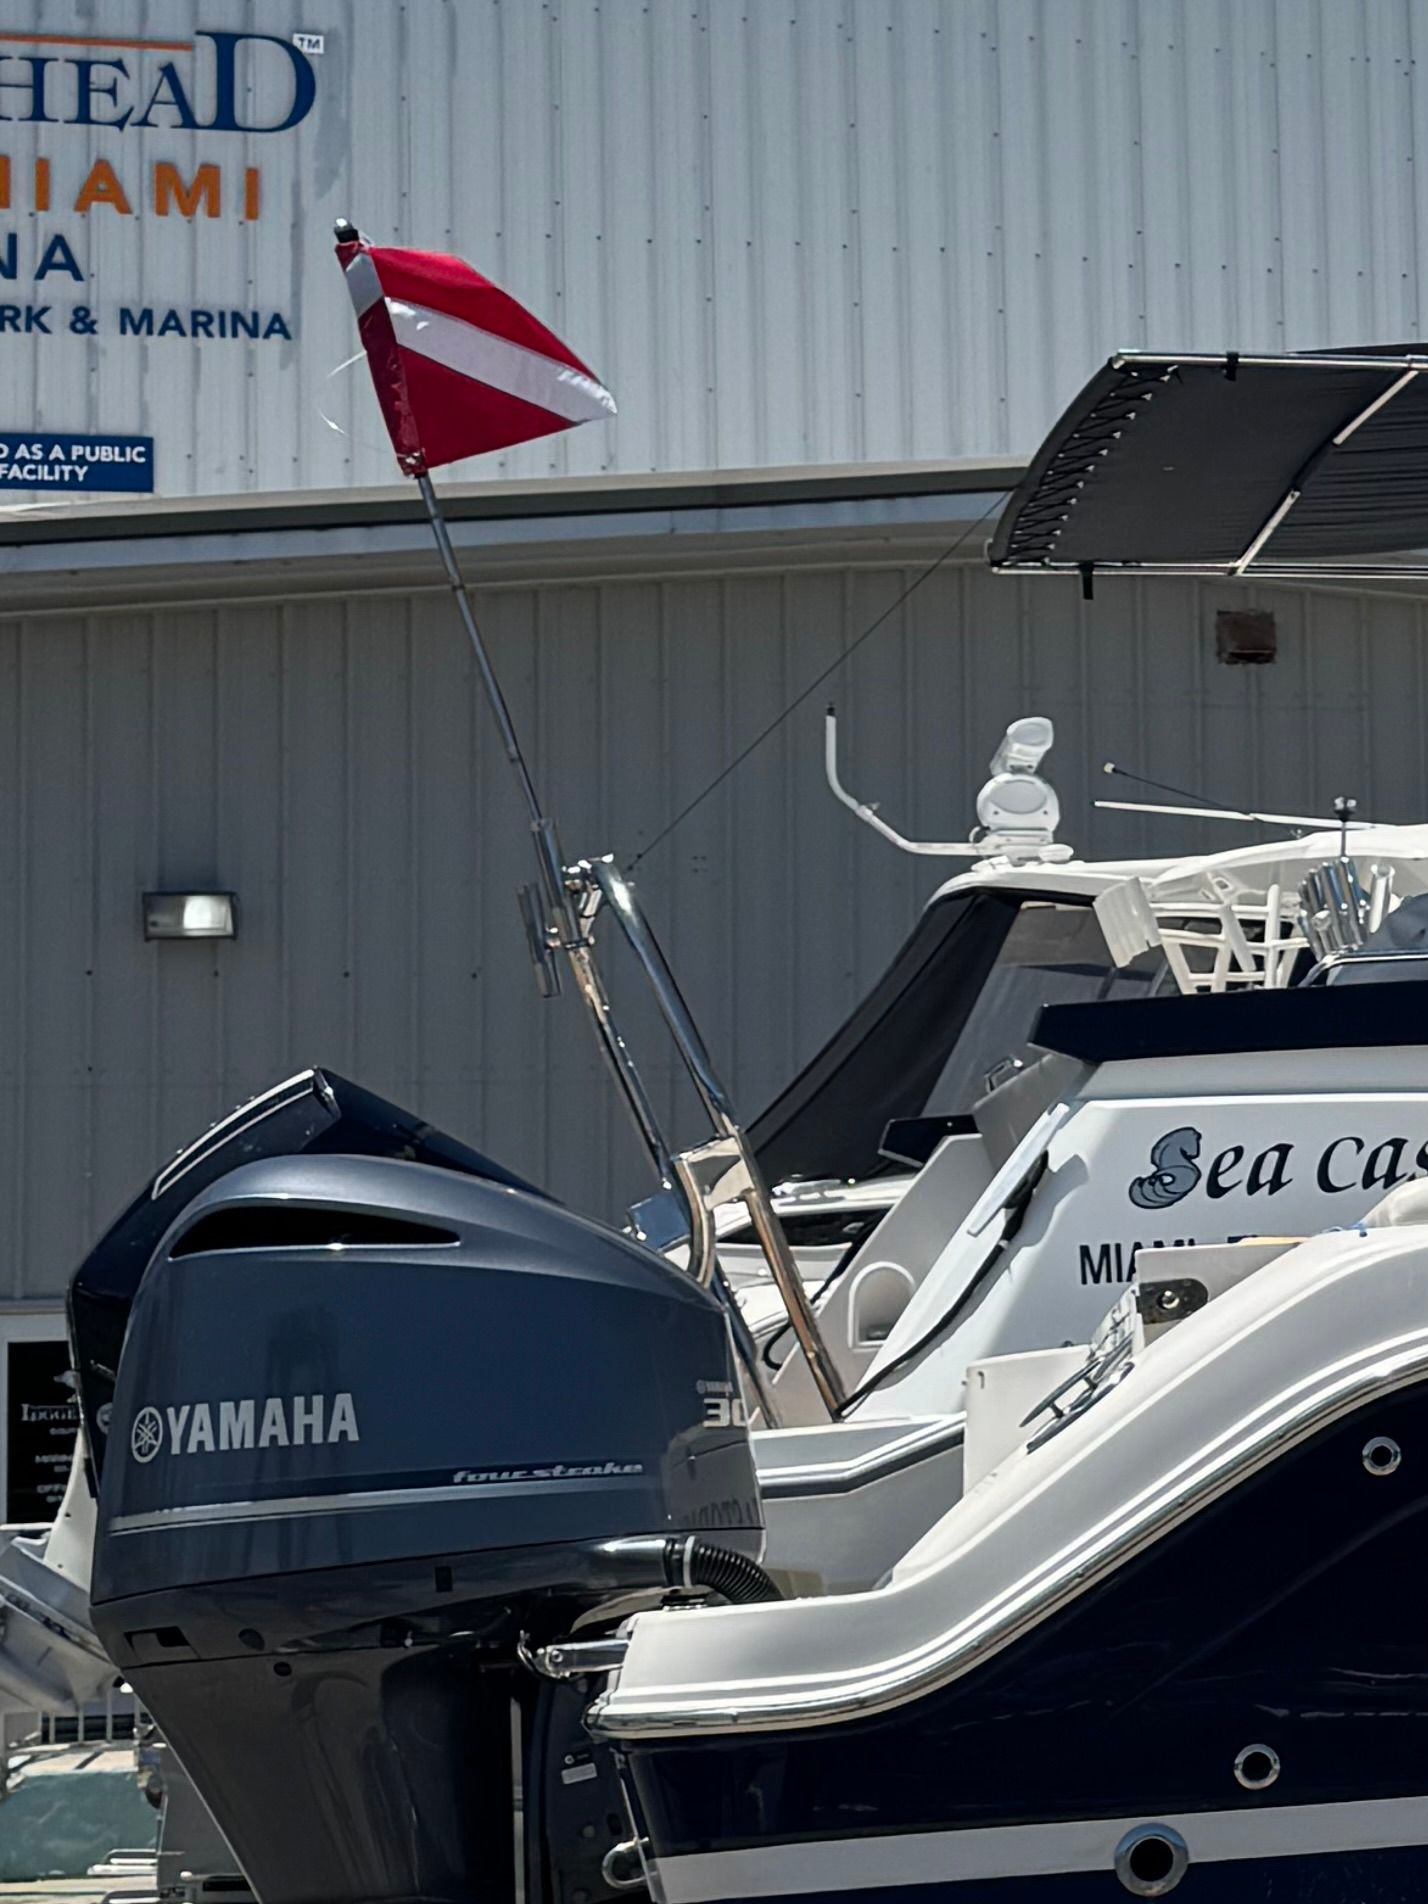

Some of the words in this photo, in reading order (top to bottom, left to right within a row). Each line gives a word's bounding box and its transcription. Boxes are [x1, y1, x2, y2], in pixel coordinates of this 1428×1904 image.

[0, 154, 259, 221] IAMI
[69, 306, 97, 335] &
[119, 308, 292, 340] MARINA
[14, 443, 43, 460] AS
[49, 444, 65, 461] A
[71, 445, 146, 463] PUBLIC
[1129, 1126, 1295, 1209] Sea
[166, 1393, 360, 1455] YAMAHA
